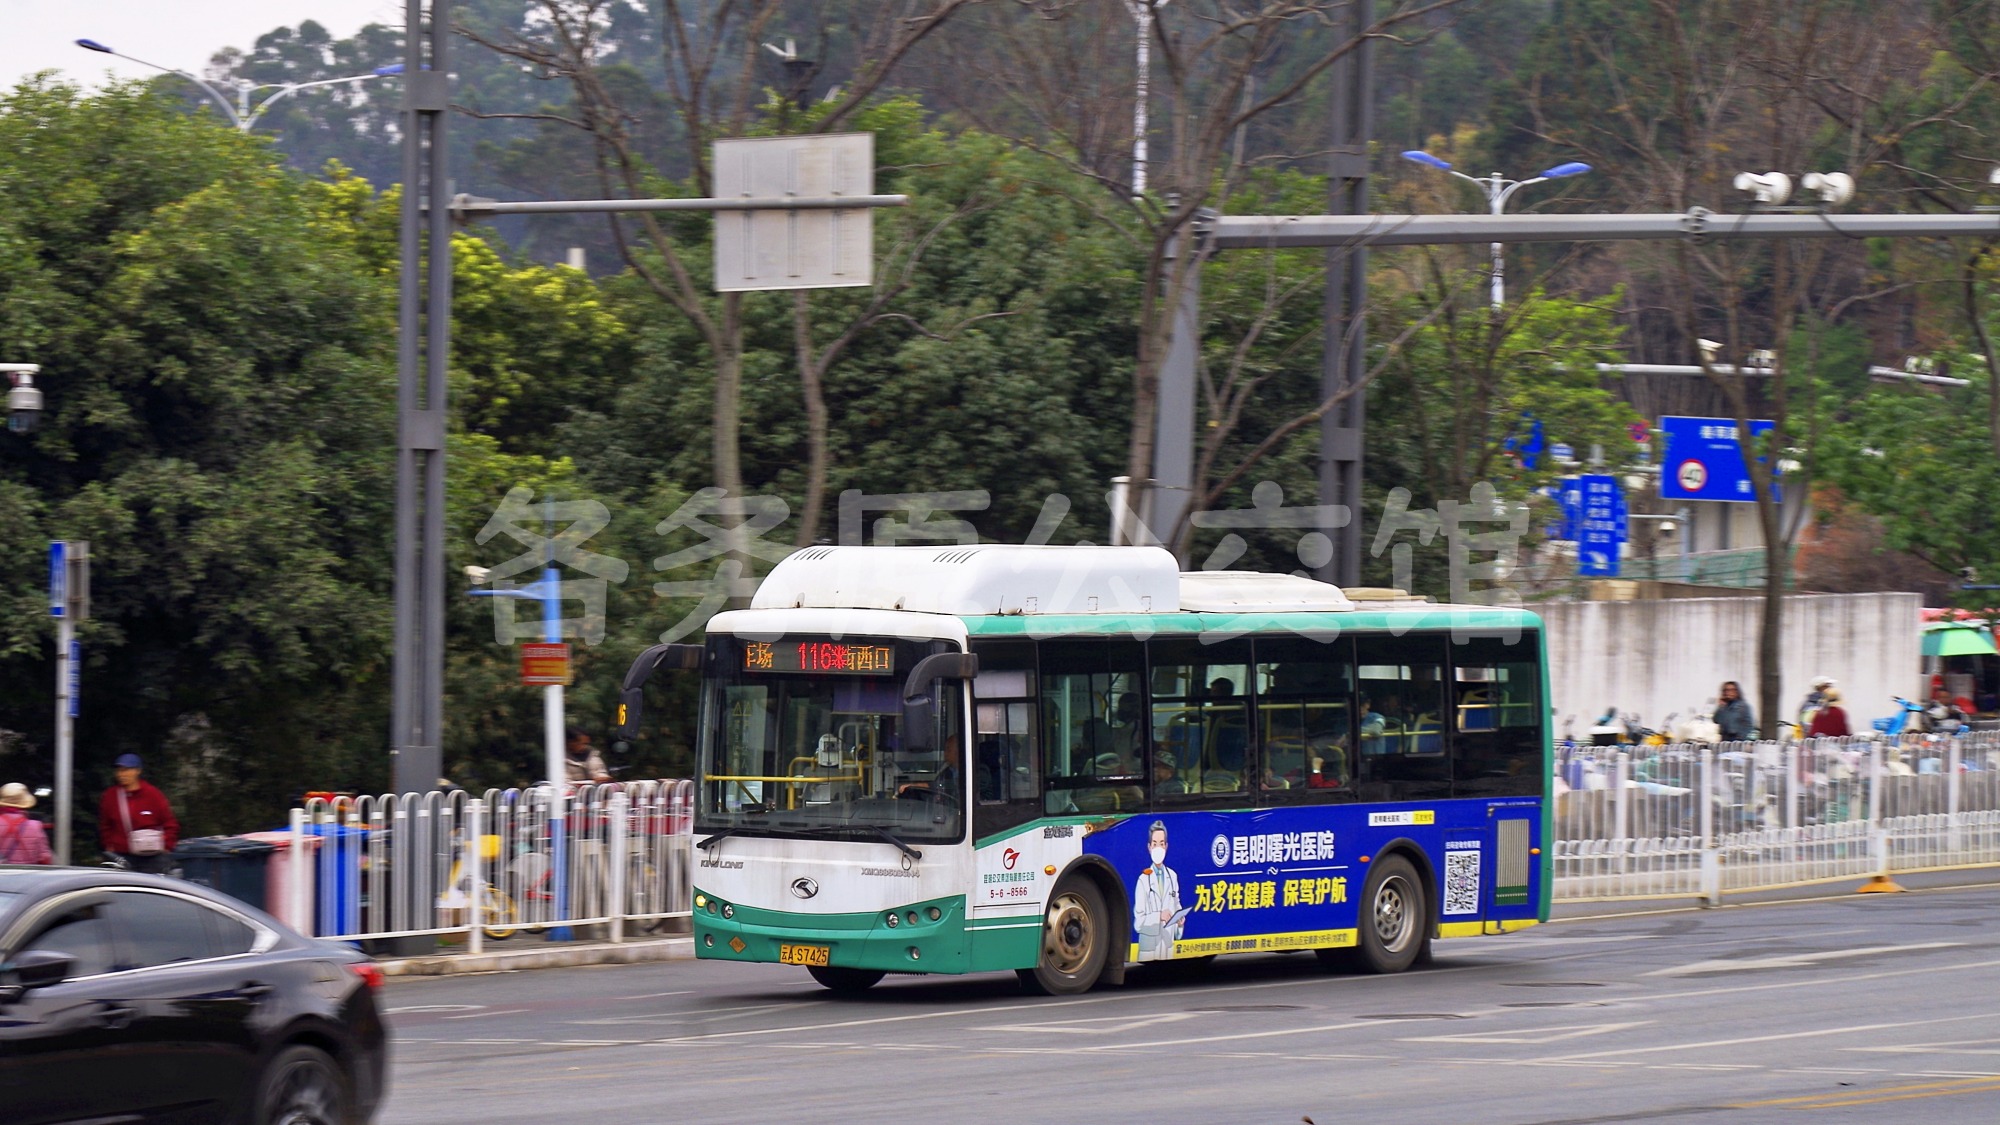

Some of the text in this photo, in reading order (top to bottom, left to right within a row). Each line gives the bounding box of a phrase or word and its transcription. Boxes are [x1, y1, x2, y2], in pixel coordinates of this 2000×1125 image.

[1232, 830, 1335, 866] 昆明曙光医院
[1194, 876, 1348, 914] 为男性健康 保驾护航
